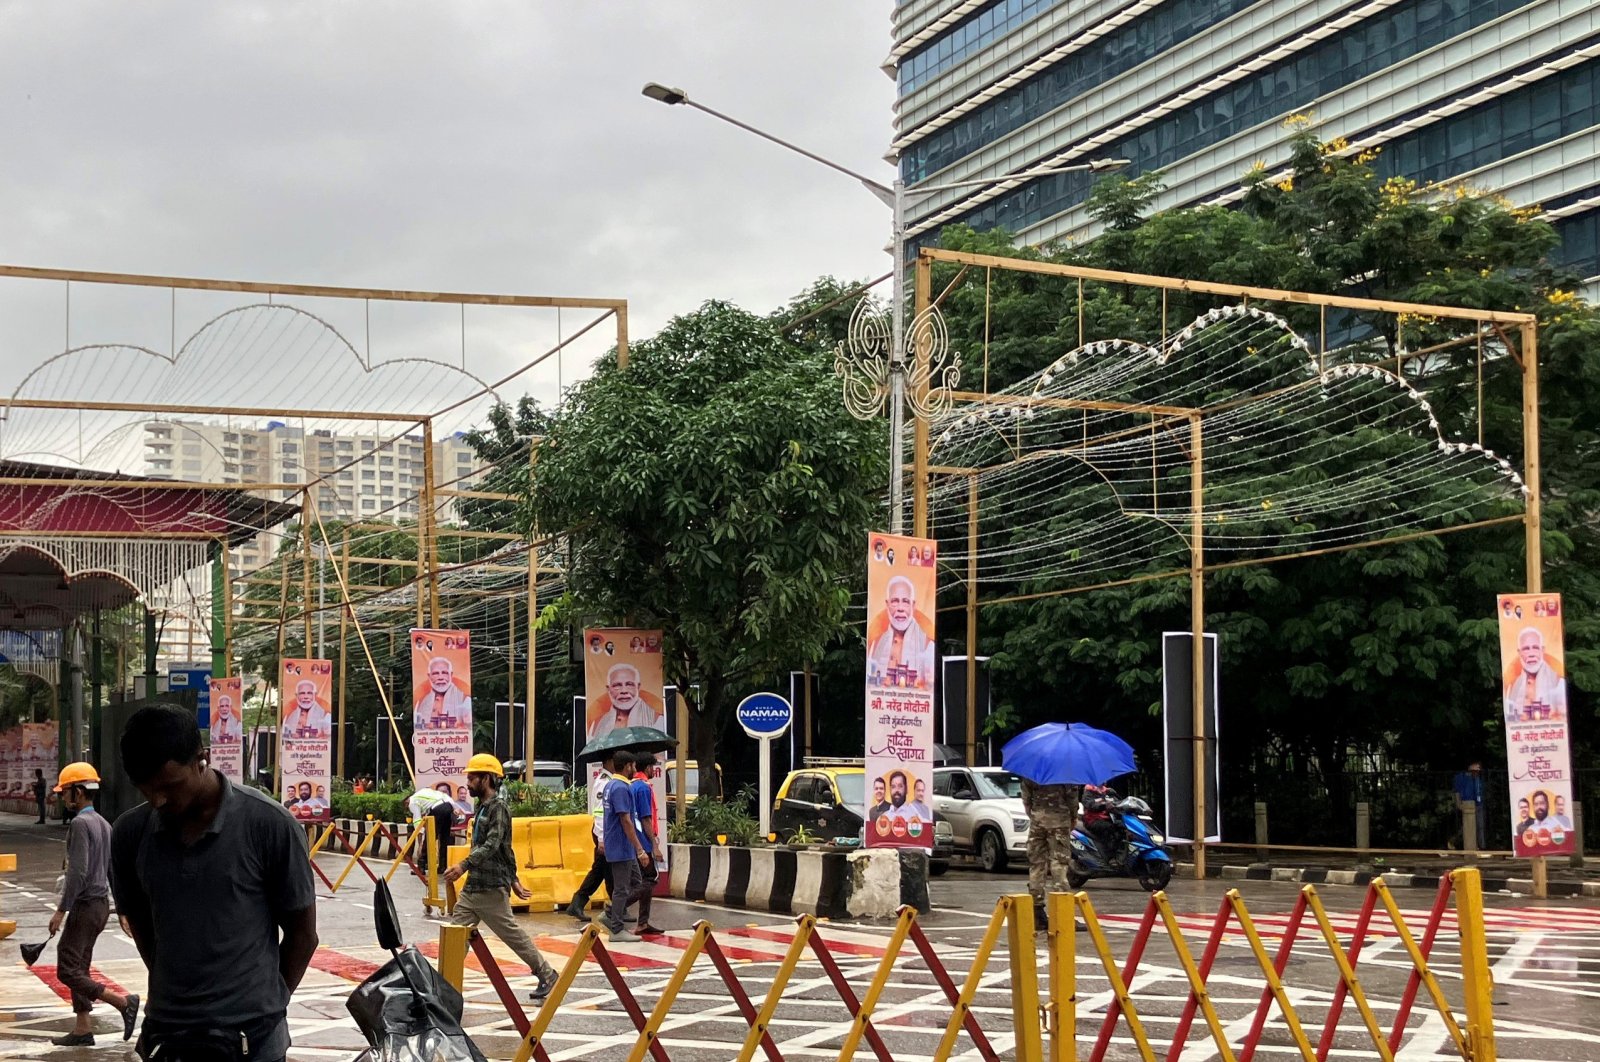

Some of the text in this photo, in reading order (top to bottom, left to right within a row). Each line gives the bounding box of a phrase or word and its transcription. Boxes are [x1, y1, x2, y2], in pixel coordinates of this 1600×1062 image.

[871, 697, 930, 714] श्री. नरेंद्र मोदीजी
[896, 747, 925, 761] स्वागत
